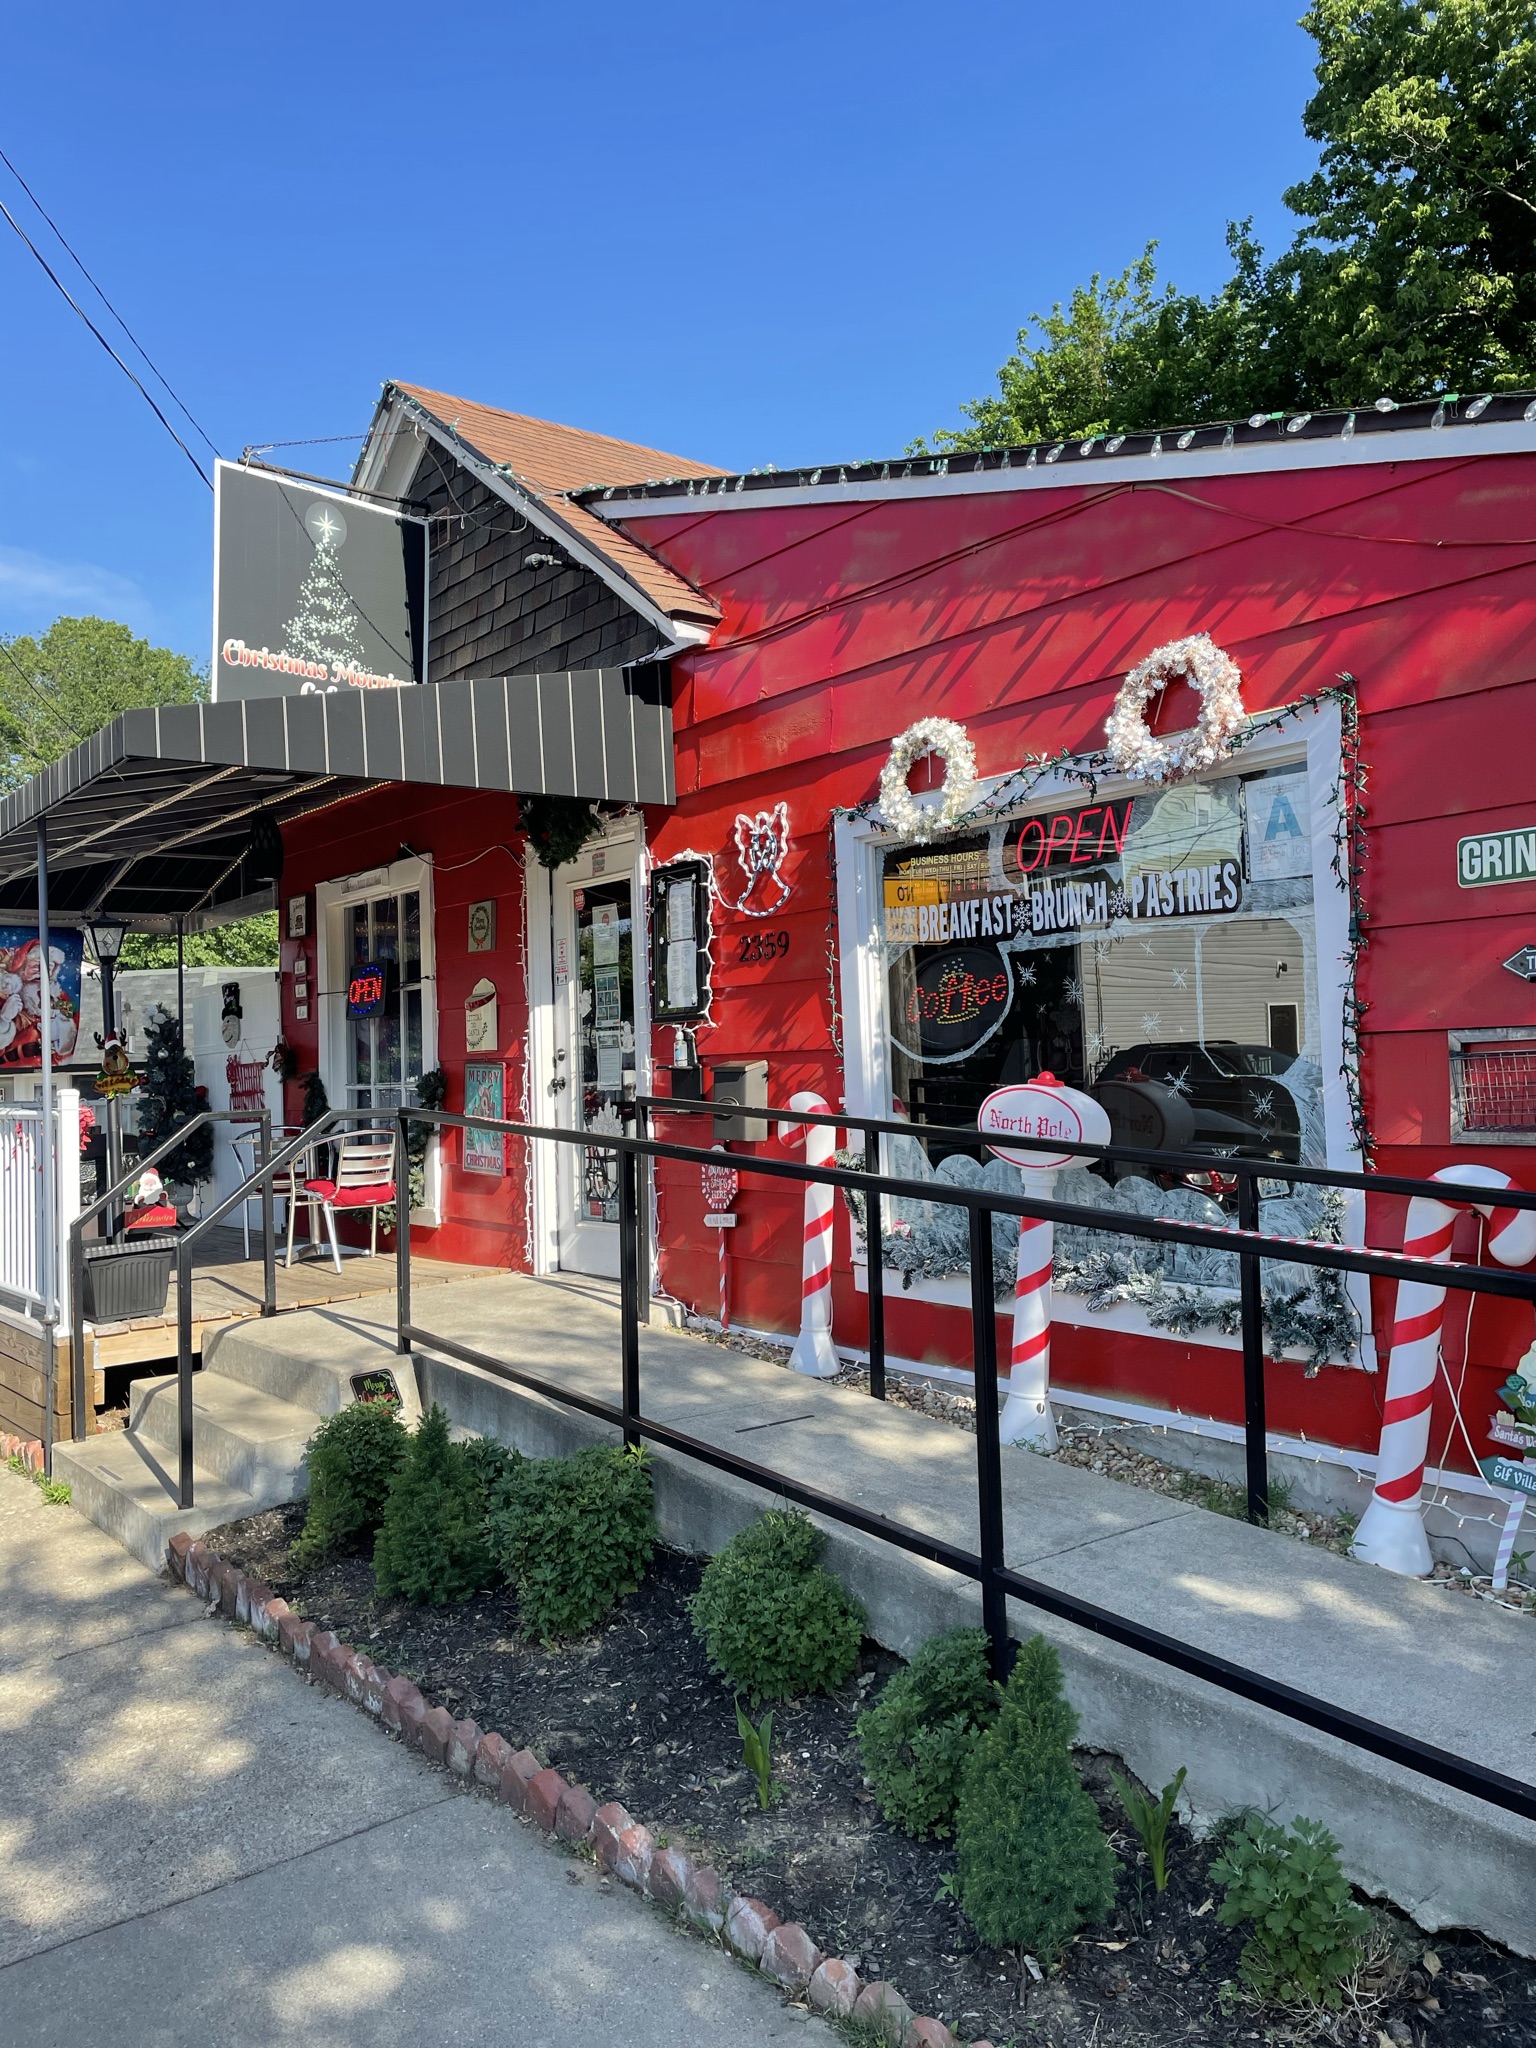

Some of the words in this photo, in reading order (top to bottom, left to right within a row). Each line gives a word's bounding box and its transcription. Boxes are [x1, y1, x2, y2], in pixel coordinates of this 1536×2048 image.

[221, 638, 328, 680] Christmas
[330, 659, 417, 690] Morni
[1263, 795, 1303, 842] A
[1016, 801, 1134, 872] OPEN
[910, 854, 949, 867] BUSINESS
[951, 851, 980, 862] HOURS
[919, 894, 1013, 943] BREAKFAST
[1031, 880, 1108, 931] BRUNCH
[1131, 862, 1238, 919] PASTRIES
[739, 930, 790, 962] 2359
[349, 976, 382, 1003] OPEN
[468, 1069, 500, 1084] MERRY
[988, 1108, 1032, 1135] North
[1036, 1116, 1072, 1139] Pole
[466, 1153, 501, 1170] CHRISTMAS
[711, 1190, 727, 1199] HERE
[1494, 1426, 1524, 1445] Santa's
[1493, 1465, 1512, 1482] Elf
